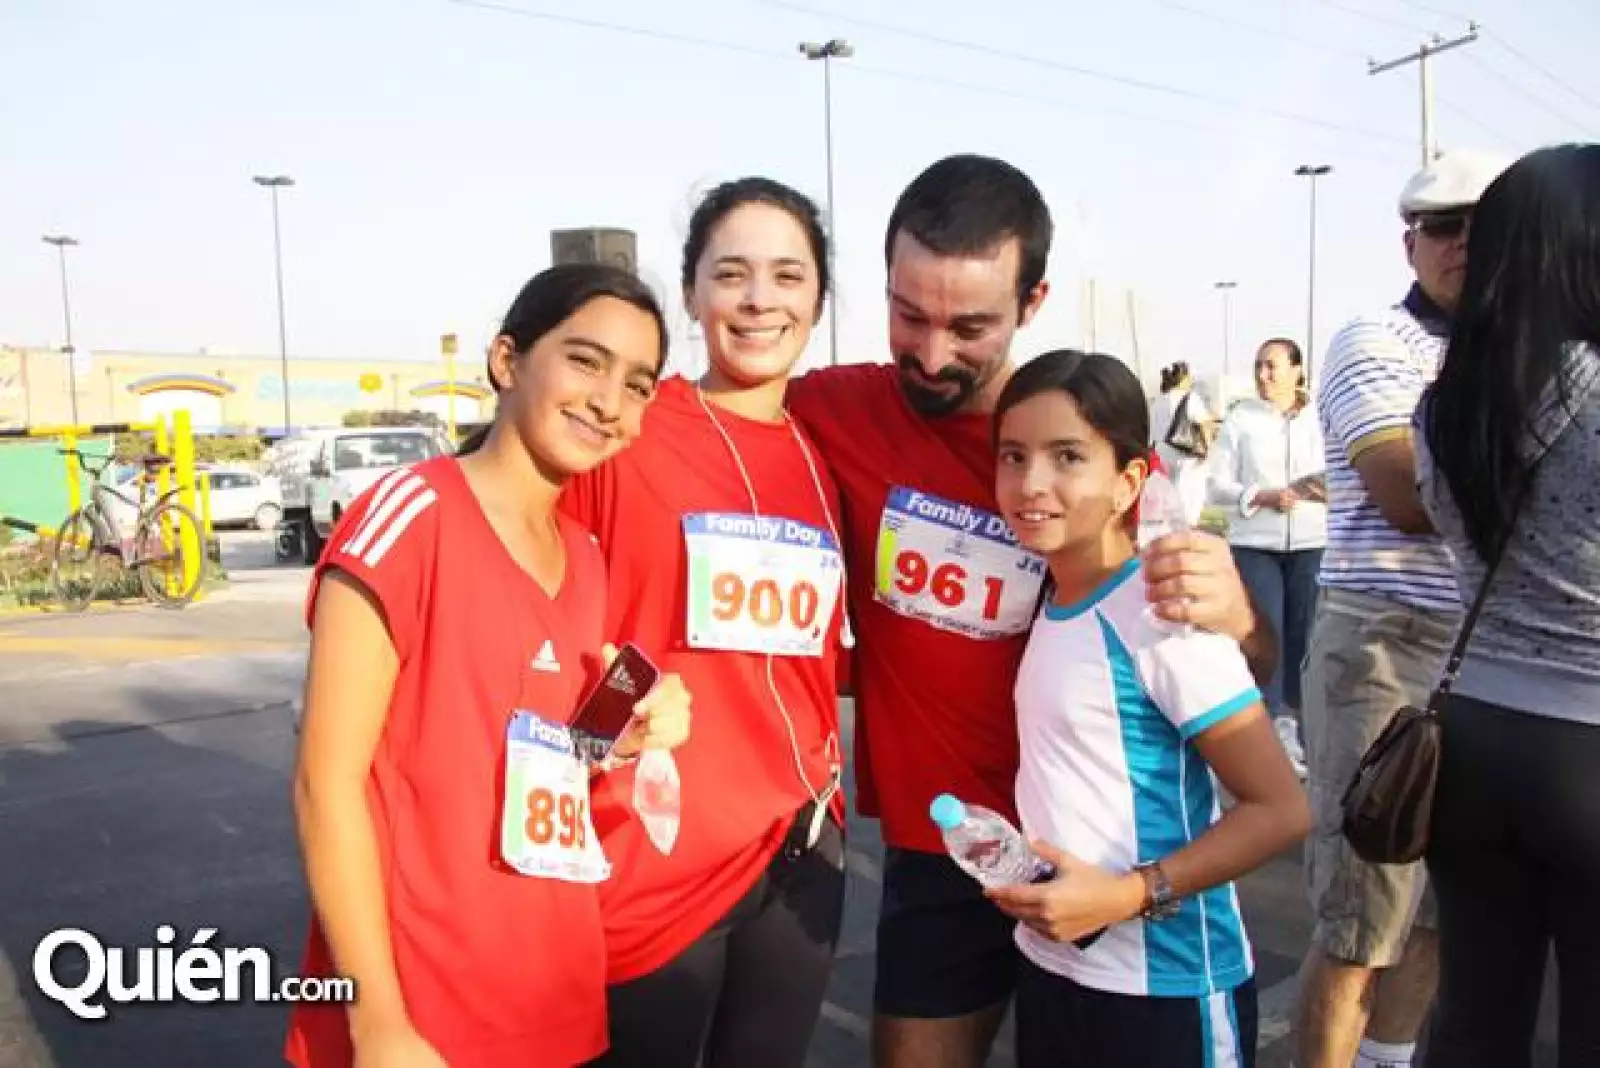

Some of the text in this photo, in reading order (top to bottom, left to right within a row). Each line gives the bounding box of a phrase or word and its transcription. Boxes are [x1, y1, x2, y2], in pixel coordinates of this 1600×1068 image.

[706, 513, 821, 550] Family Day
[907, 492, 983, 529] Family
[985, 516, 1018, 542] Da
[712, 572, 818, 631] 900
[894, 549, 1004, 621] 961
